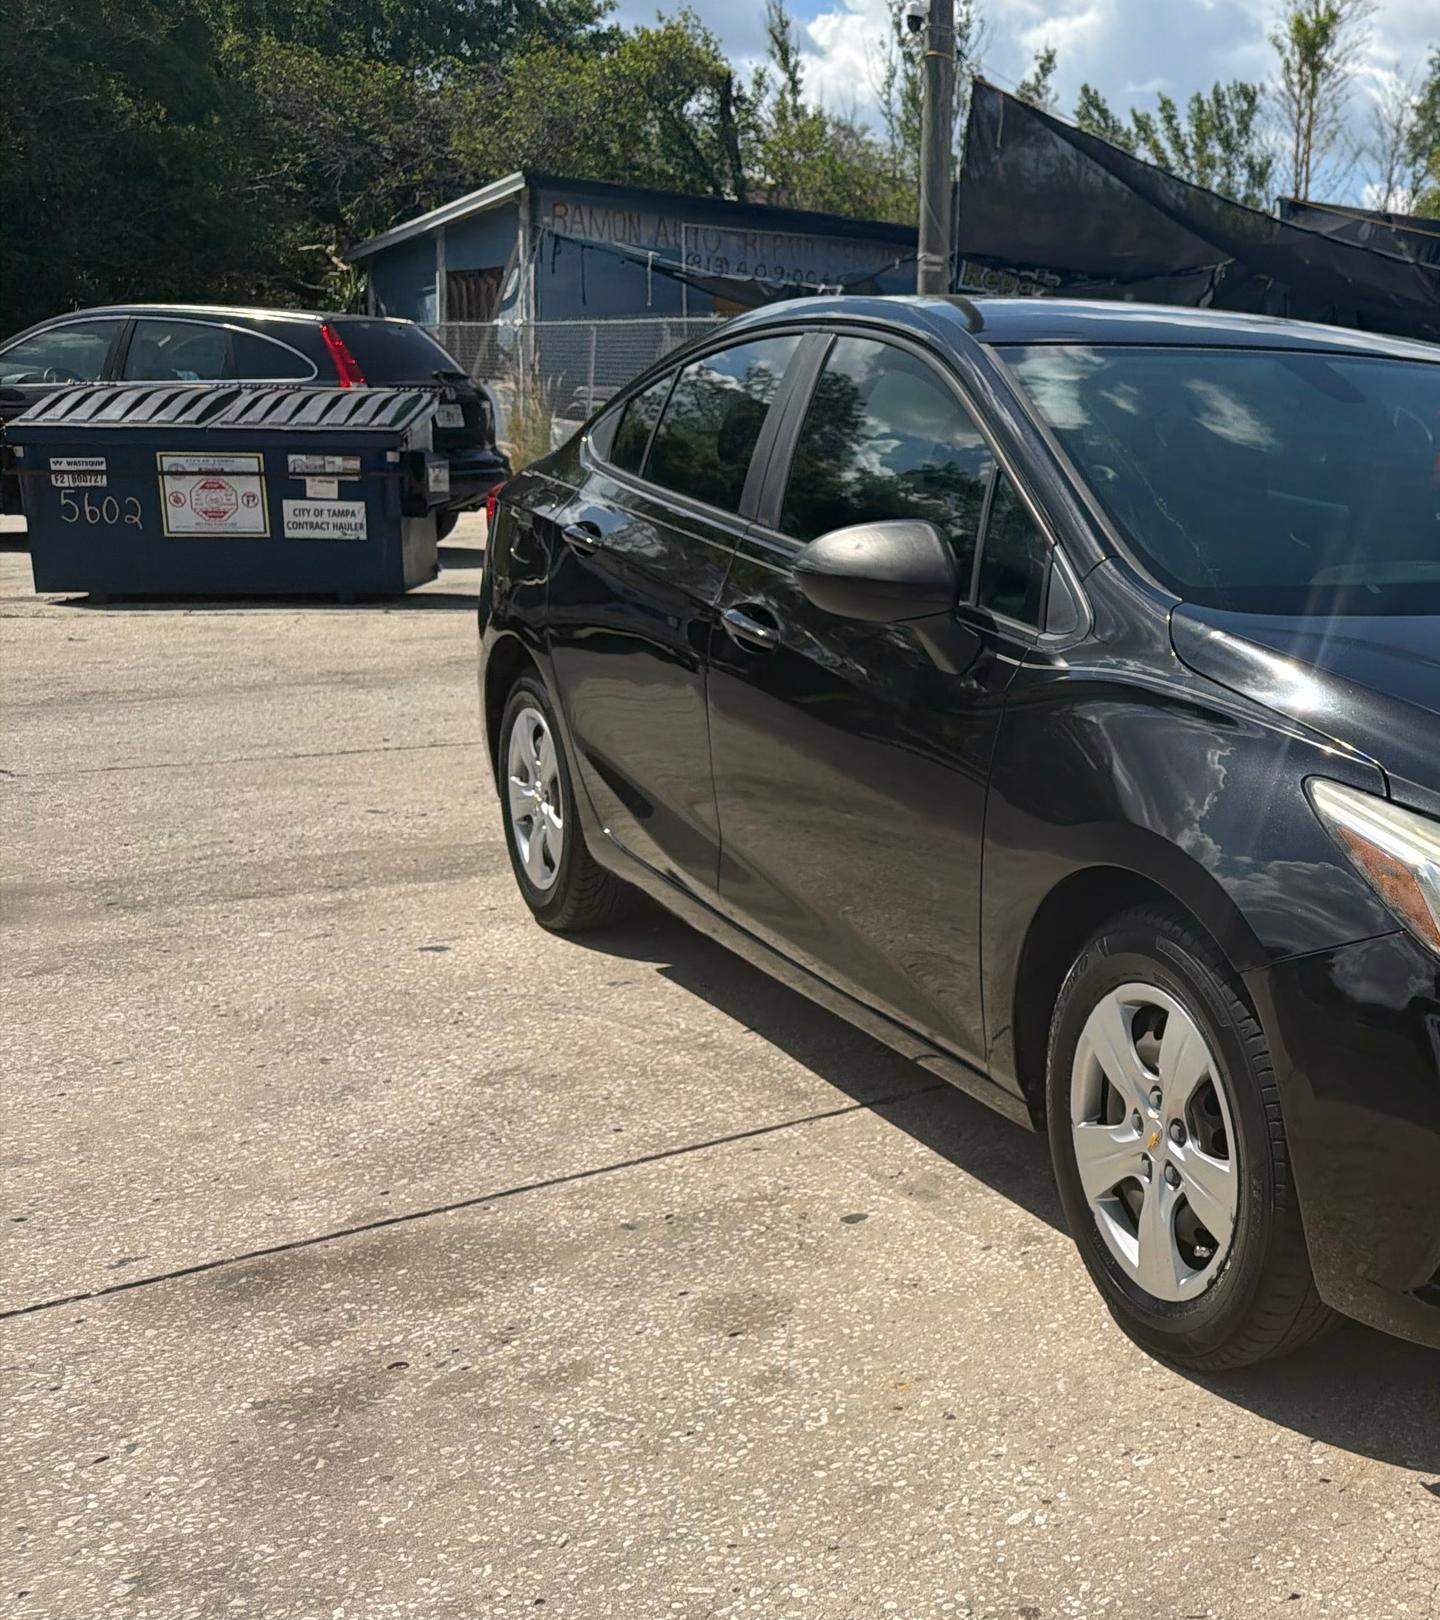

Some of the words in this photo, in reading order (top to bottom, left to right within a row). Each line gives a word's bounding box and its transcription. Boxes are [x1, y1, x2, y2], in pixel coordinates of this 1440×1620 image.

[551, 203, 641, 243] RAMON
[655, 216, 721, 254] AUTO
[60, 489, 143, 531] 5602
[292, 508, 311, 518] CITY
[313, 508, 324, 517] OF
[326, 508, 357, 518] TAMPA
[286, 520, 330, 531] CONTRACT
[332, 522, 364, 533] HAULER
